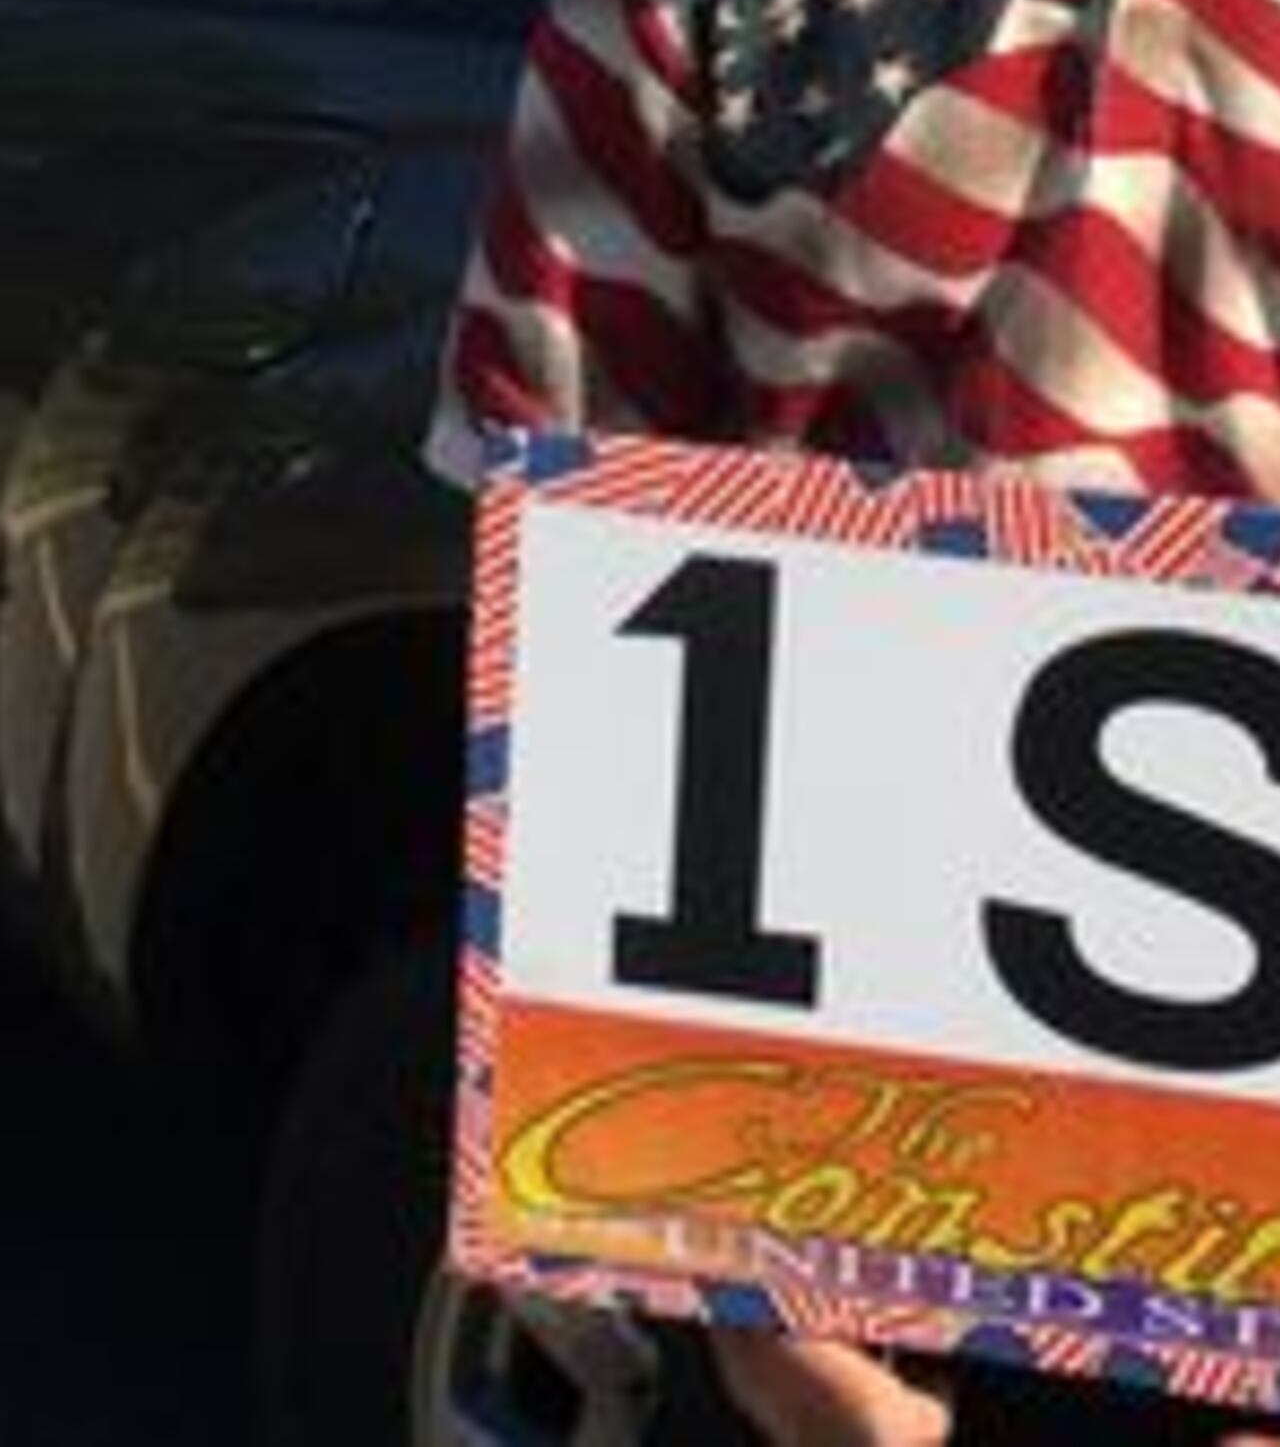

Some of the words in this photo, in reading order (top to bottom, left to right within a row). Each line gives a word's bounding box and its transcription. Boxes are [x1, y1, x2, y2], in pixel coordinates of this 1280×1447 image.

[611, 552, 822, 1011] 1
[740, 1066, 1034, 1169] The
[664, 1216, 1108, 1322] UNITED
